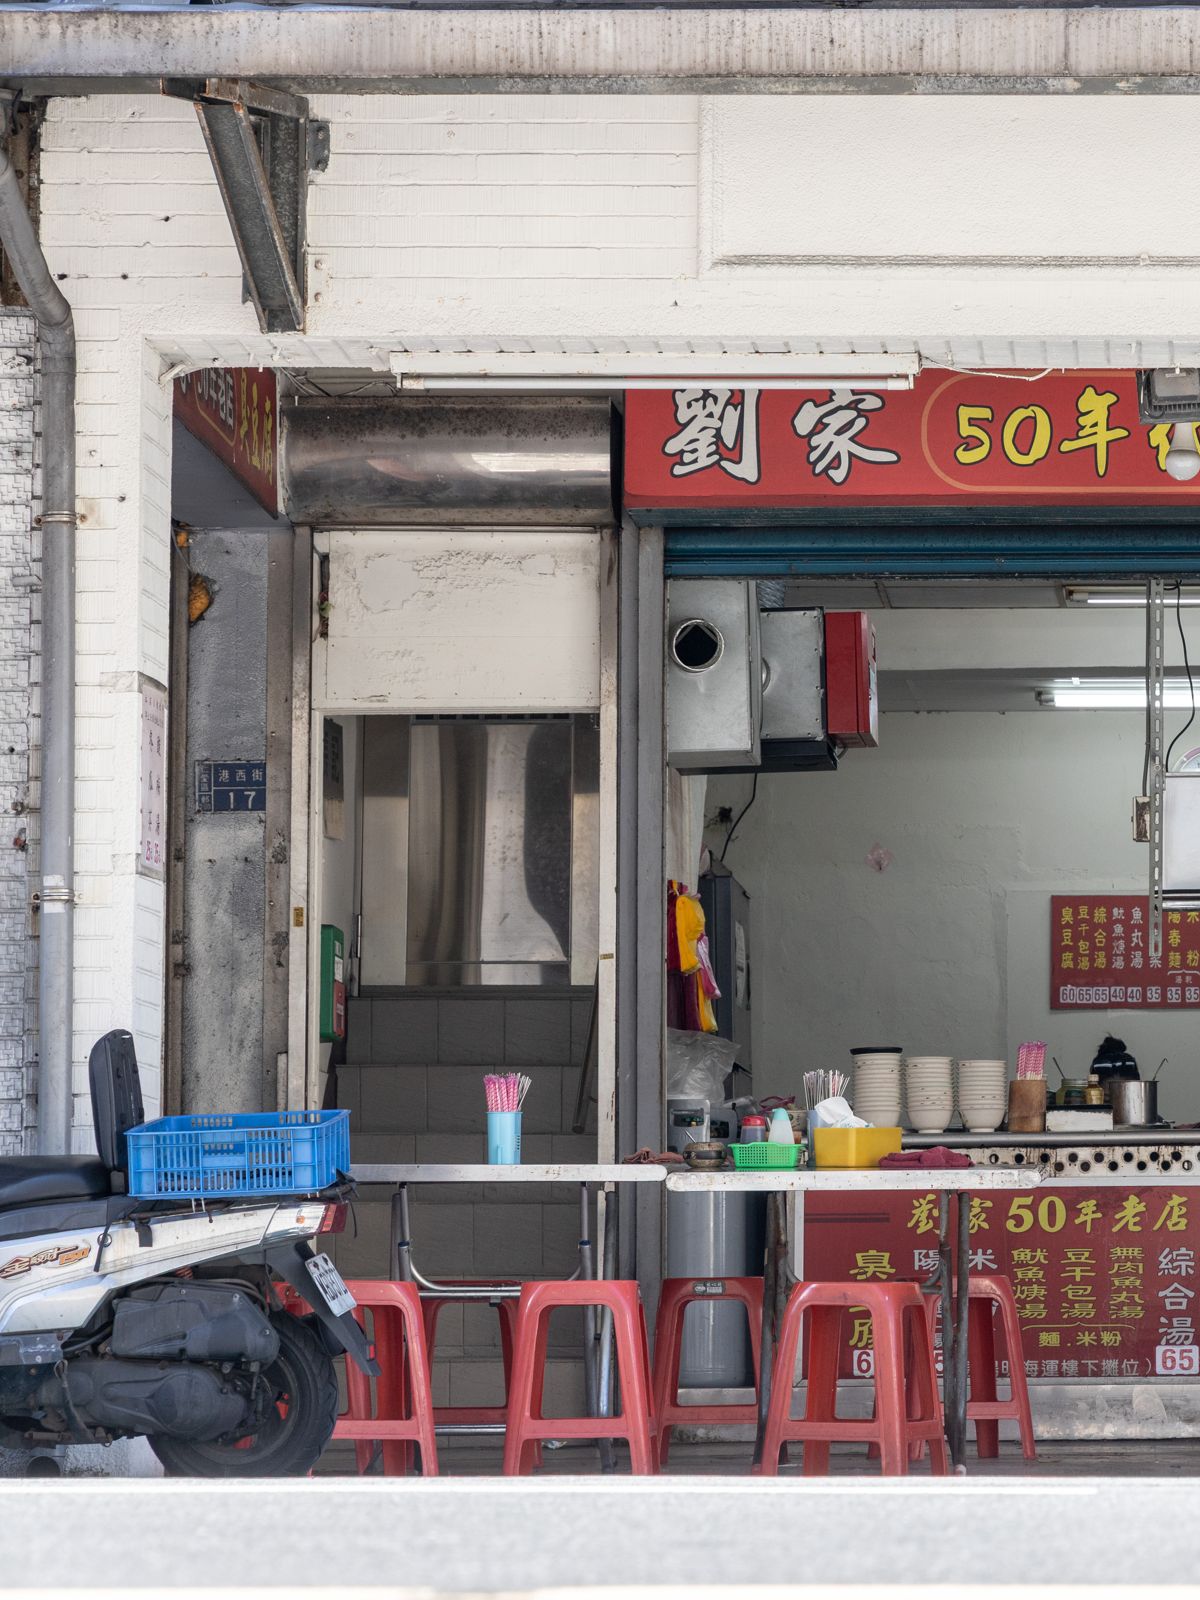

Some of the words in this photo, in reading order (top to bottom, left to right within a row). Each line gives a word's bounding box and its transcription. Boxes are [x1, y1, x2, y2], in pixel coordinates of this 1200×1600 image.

[662, 388, 901, 485] 劉家
[219, 768, 263, 782] 港西街
[229, 791, 256, 809] 17
[1060, 907, 1074, 969] 臭豆腐
[1093, 906, 1107, 969] 綜合湯
[1131, 907, 1144, 969] 魚丸湯
[1061, 987, 1075, 1001] 60
[1078, 987, 1091, 1001] 65
[1094, 987, 1108, 1001] 65
[1112, 987, 1125, 1001] 40
[1128, 987, 1141, 1001] 40
[1147, 987, 1160, 1001] 35
[1168, 987, 1181, 1001] 35
[1186, 987, 1199, 1001] 35
[1060, 1248, 1097, 1319] 豆干包湯
[1108, 1247, 1146, 1319] 無肉魚丸湯
[1157, 1247, 1195, 1346] 綜合湯
[1159, 1349, 1195, 1373] 65
